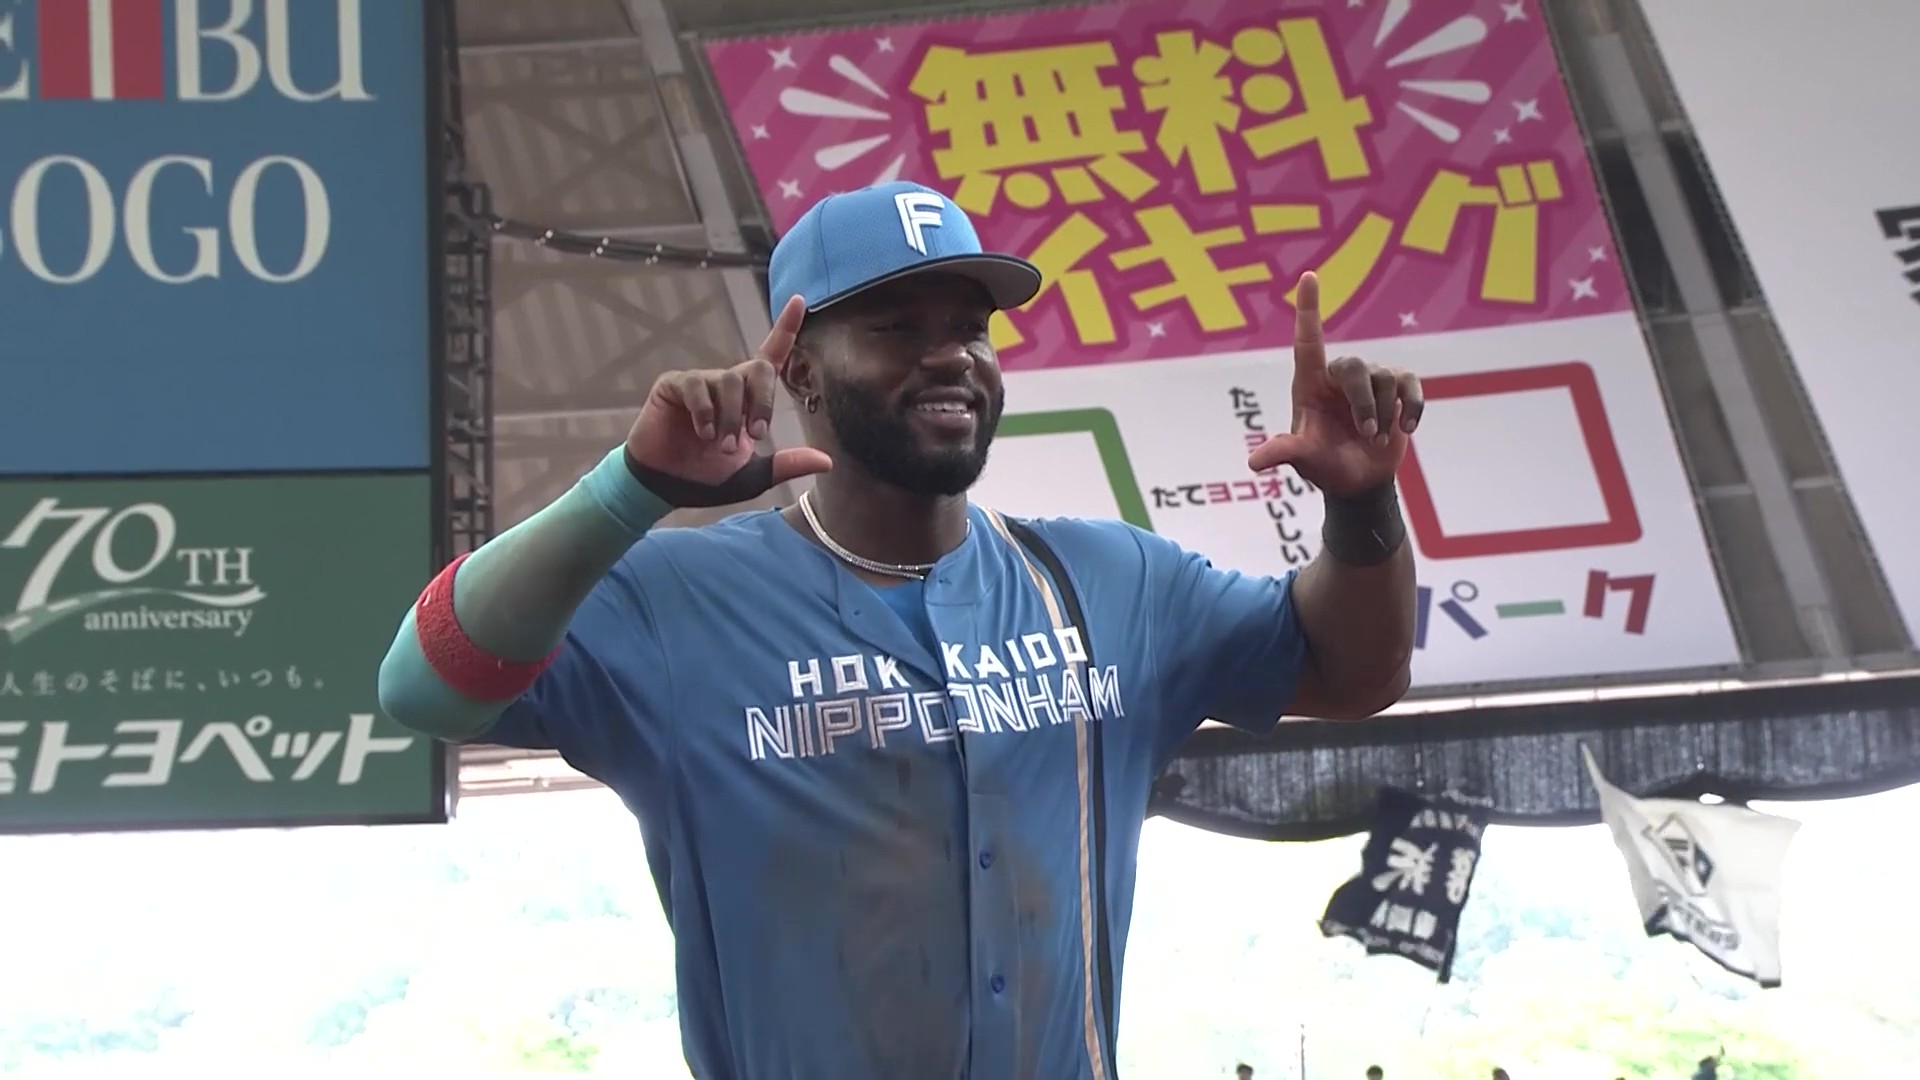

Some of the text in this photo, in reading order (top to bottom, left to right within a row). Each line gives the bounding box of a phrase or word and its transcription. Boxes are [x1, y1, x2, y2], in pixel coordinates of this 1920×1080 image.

[909, 17, 1373, 217] 無料
[0, 154, 331, 284] OGO
[894, 192, 945, 257] F
[988, 158, 1563, 352] イキング
[84, 605, 254, 637] anniversary
[0, 665, 324, 697] 人生のそばに、いつも。
[745, 664, 1126, 761] NIPPONHAM
